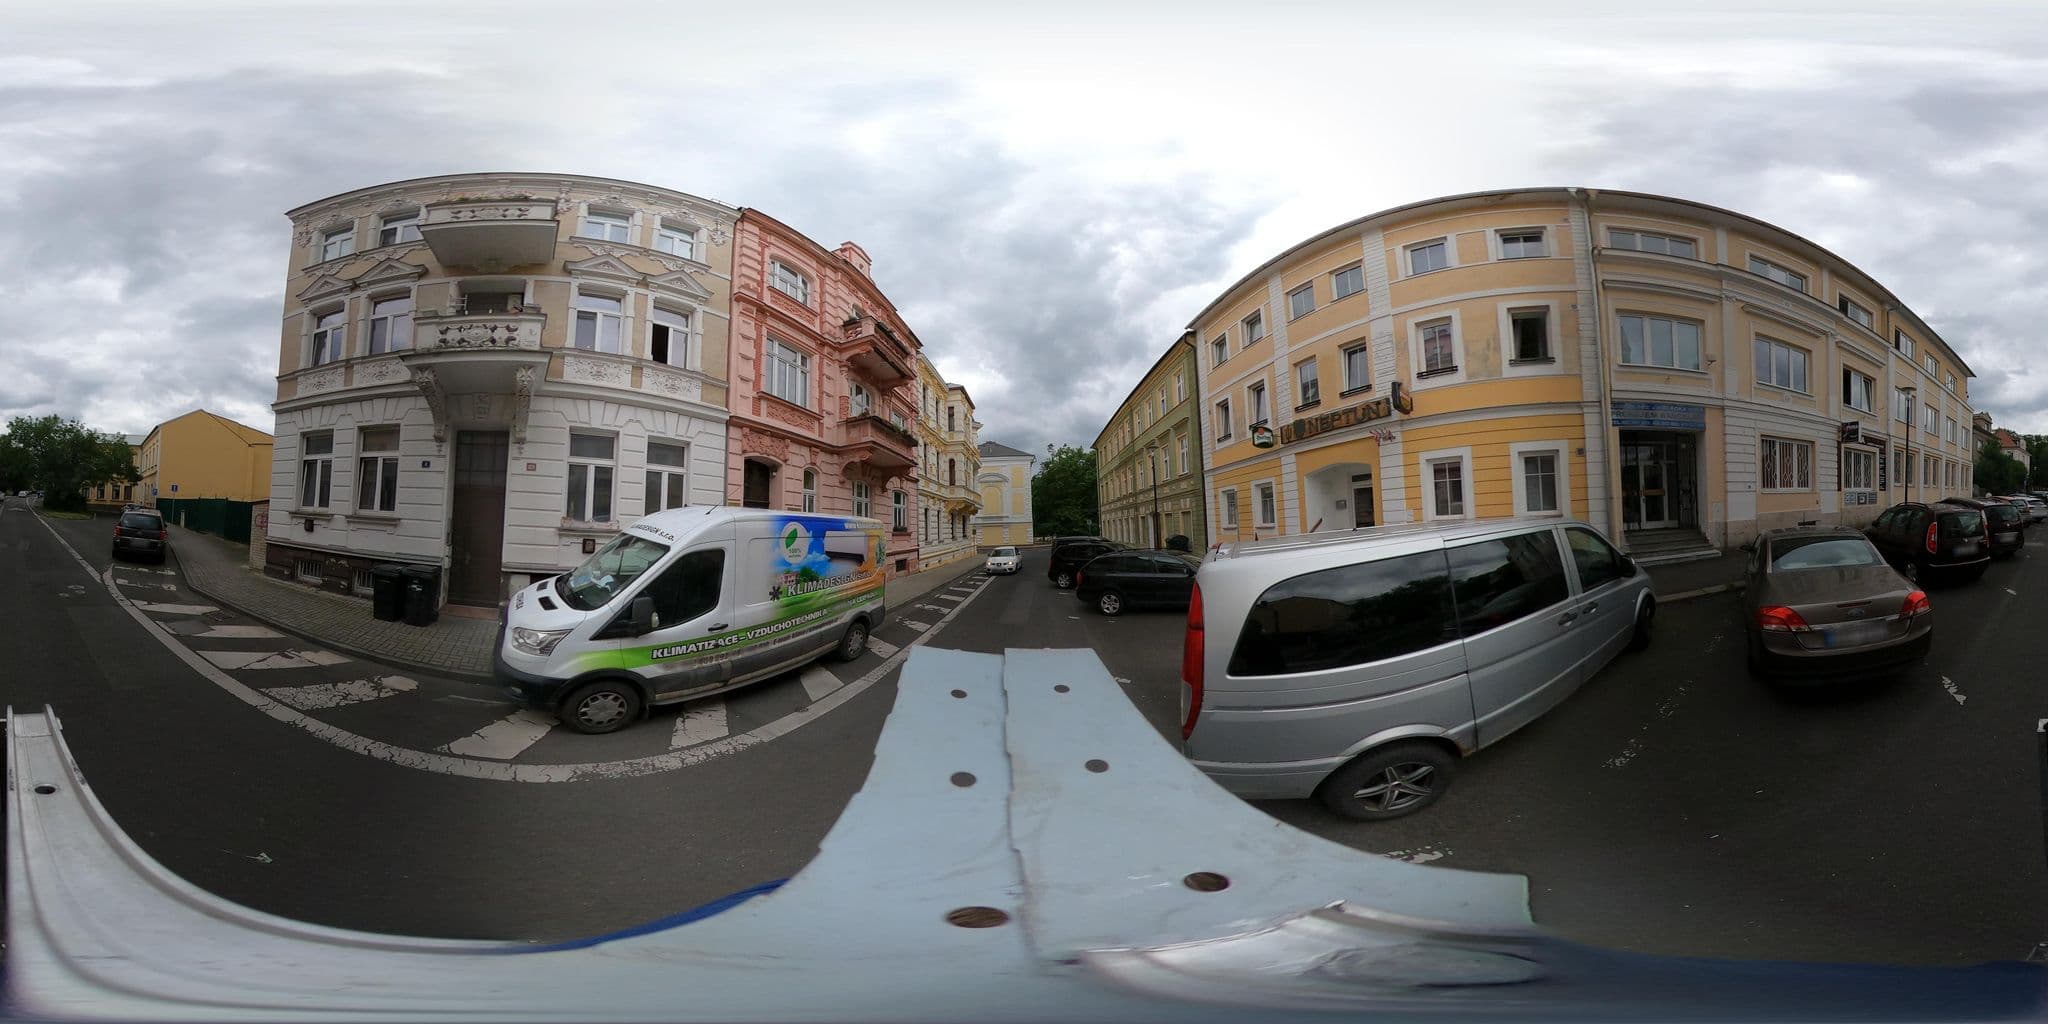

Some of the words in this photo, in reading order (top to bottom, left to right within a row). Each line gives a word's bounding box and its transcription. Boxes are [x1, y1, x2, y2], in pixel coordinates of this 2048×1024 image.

[1306, 401, 1382, 434] NEPTUN
[787, 573, 856, 596] KLIMADESIGN
[651, 634, 738, 659] KLIMATIZACE
[746, 608, 828, 640] VZDUCHOTECHNIKA
